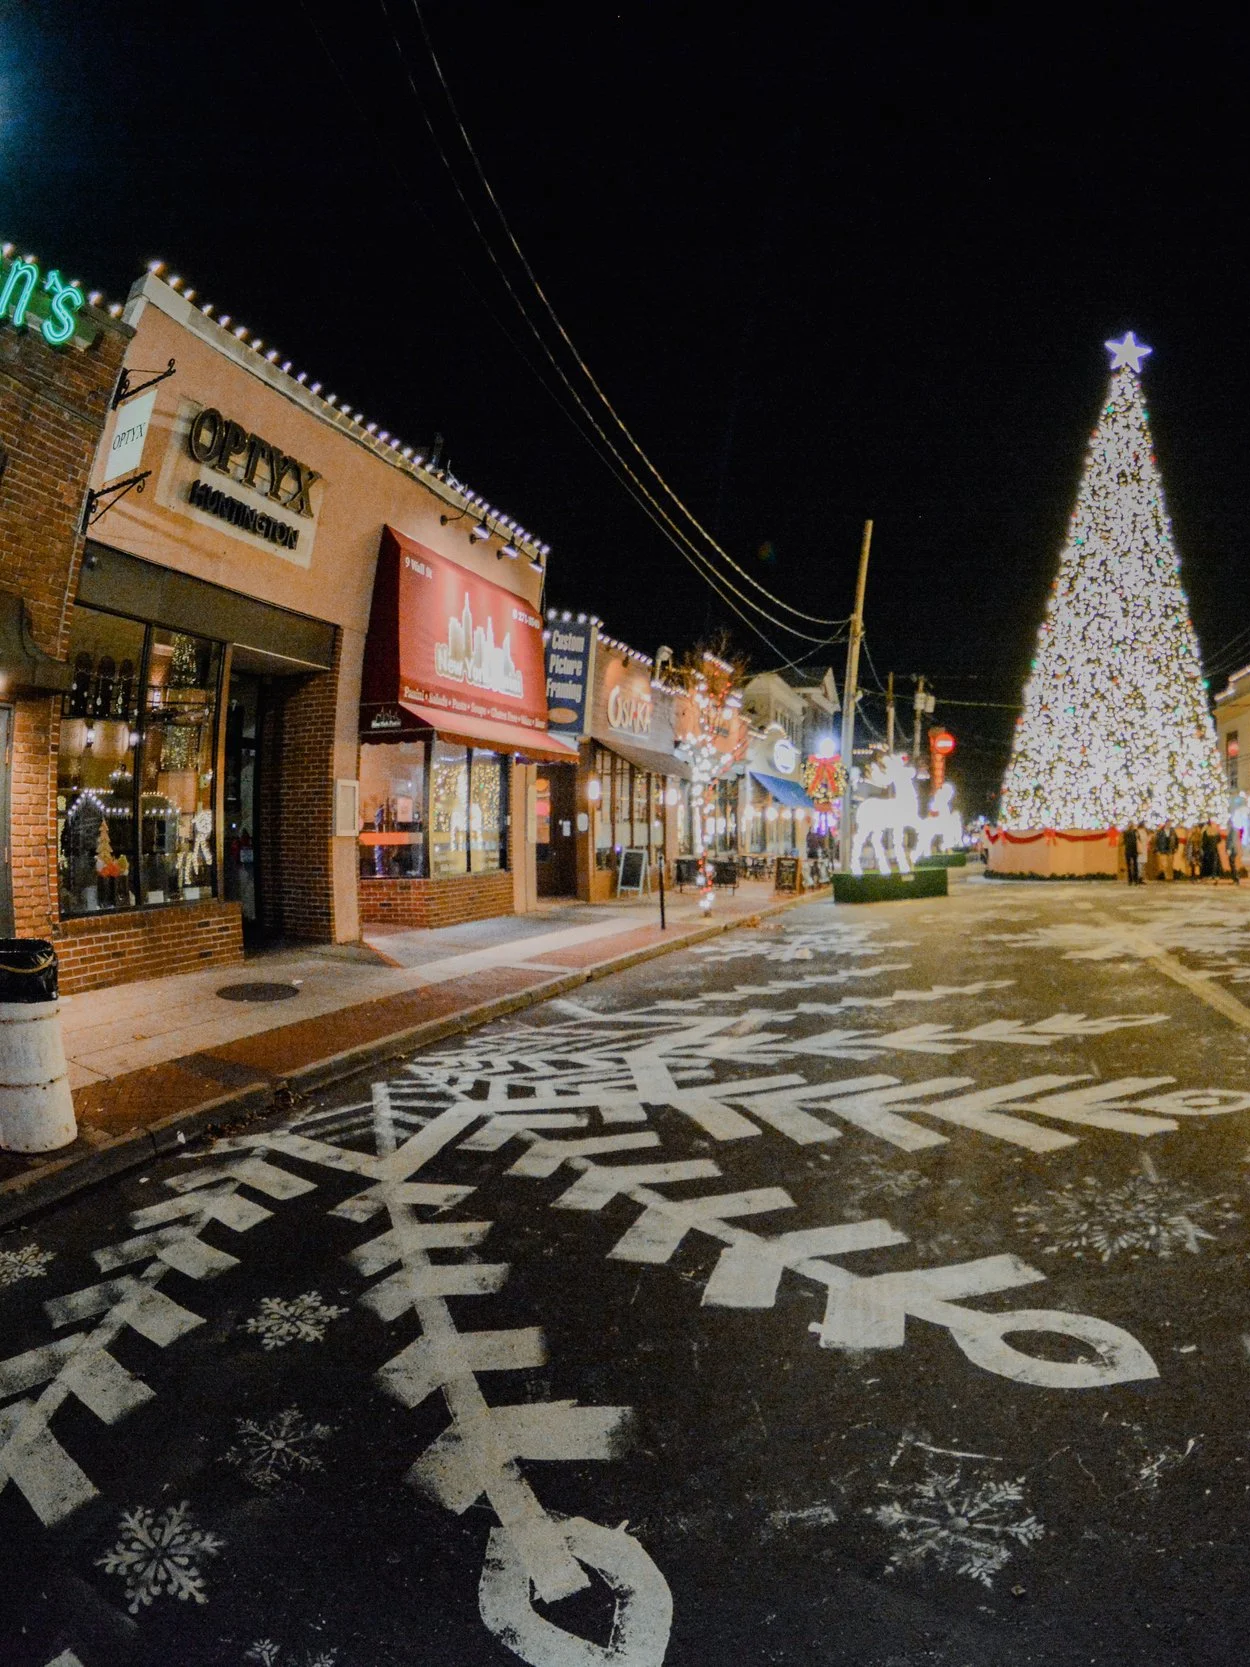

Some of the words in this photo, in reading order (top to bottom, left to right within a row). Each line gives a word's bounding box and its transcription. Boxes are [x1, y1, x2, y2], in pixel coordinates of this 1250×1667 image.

[0, 256, 84, 345] n's
[112, 422, 146, 450] OPTYX
[190, 407, 323, 519] OPTYX
[188, 479, 300, 551] HUNTINGTON
[552, 630, 585, 653] Custom
[549, 654, 583, 677] Picture
[546, 678, 583, 704] Framing
[608, 685, 651, 734] OSAKA
